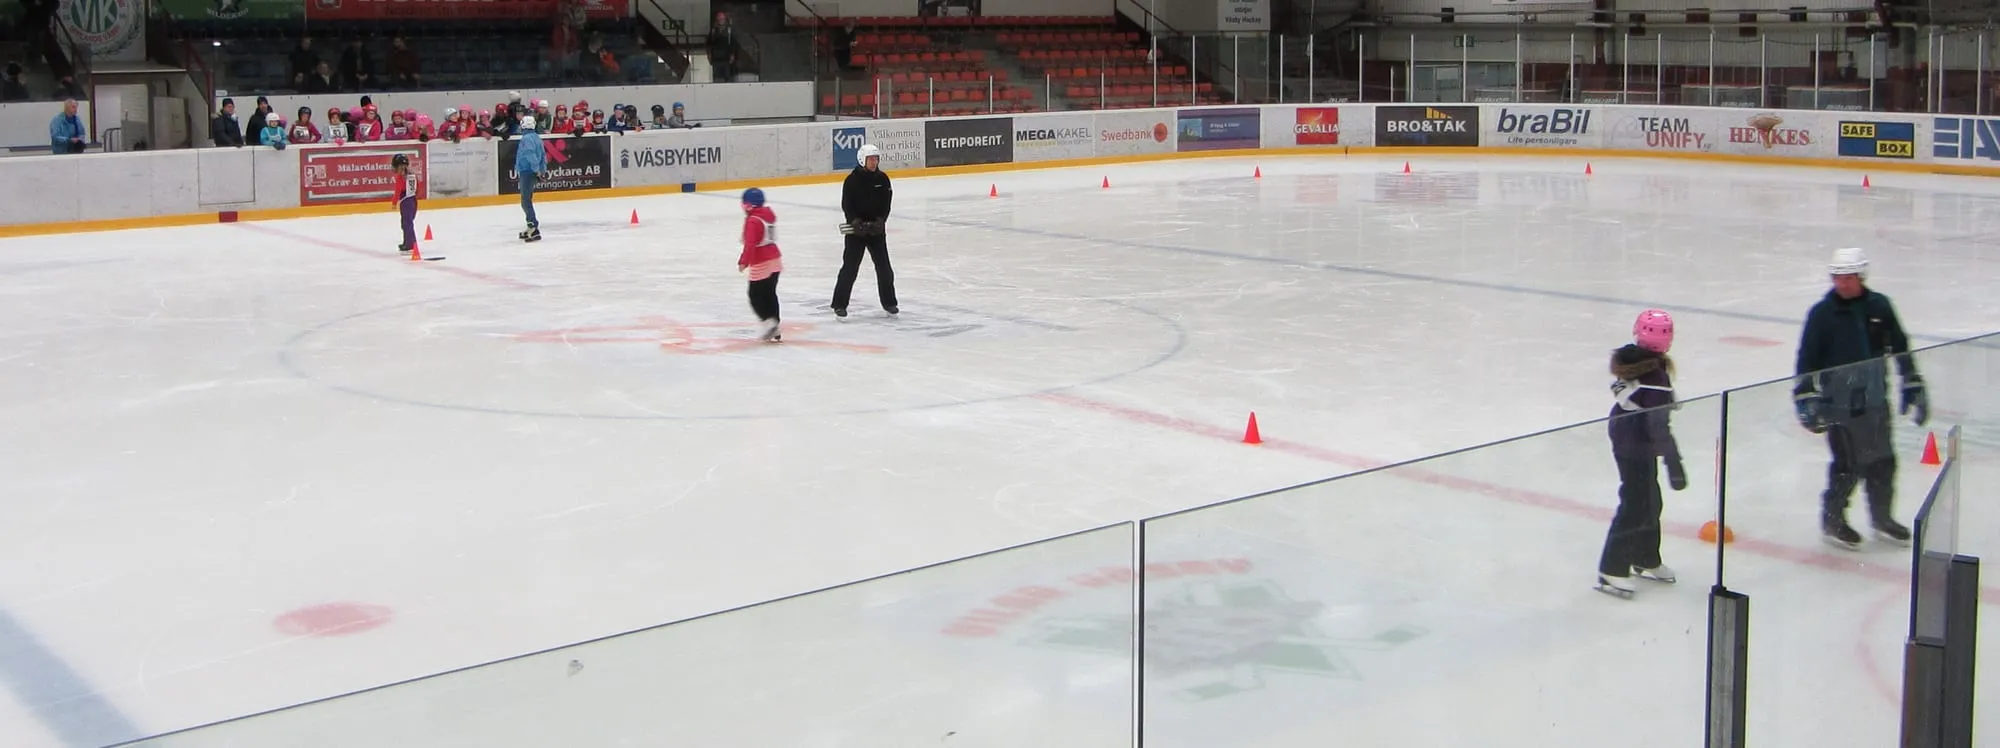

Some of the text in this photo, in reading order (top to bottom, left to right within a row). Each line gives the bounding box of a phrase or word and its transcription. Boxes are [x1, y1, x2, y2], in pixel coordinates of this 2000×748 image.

[1498, 108, 1590, 134] braBil
[1638, 117, 1689, 132] TEAM
[873, 129, 921, 139] Välkommen
[1016, 127, 1093, 142] MEGAKAKEL
[1101, 129, 1152, 142] Swedbank
[1294, 124, 1340, 135] GEVALIA
[1842, 125, 1873, 136] SAFE
[1646, 132, 1706, 148] UNIFY
[1728, 127, 1811, 145] HENKES
[1879, 143, 1909, 154] BOX
[633, 147, 721, 168] VÄSBYHEM
[879, 150, 921, 162] öbelbutik!
[585, 164, 601, 176] AB
[362, 175, 388, 185] Frakt
